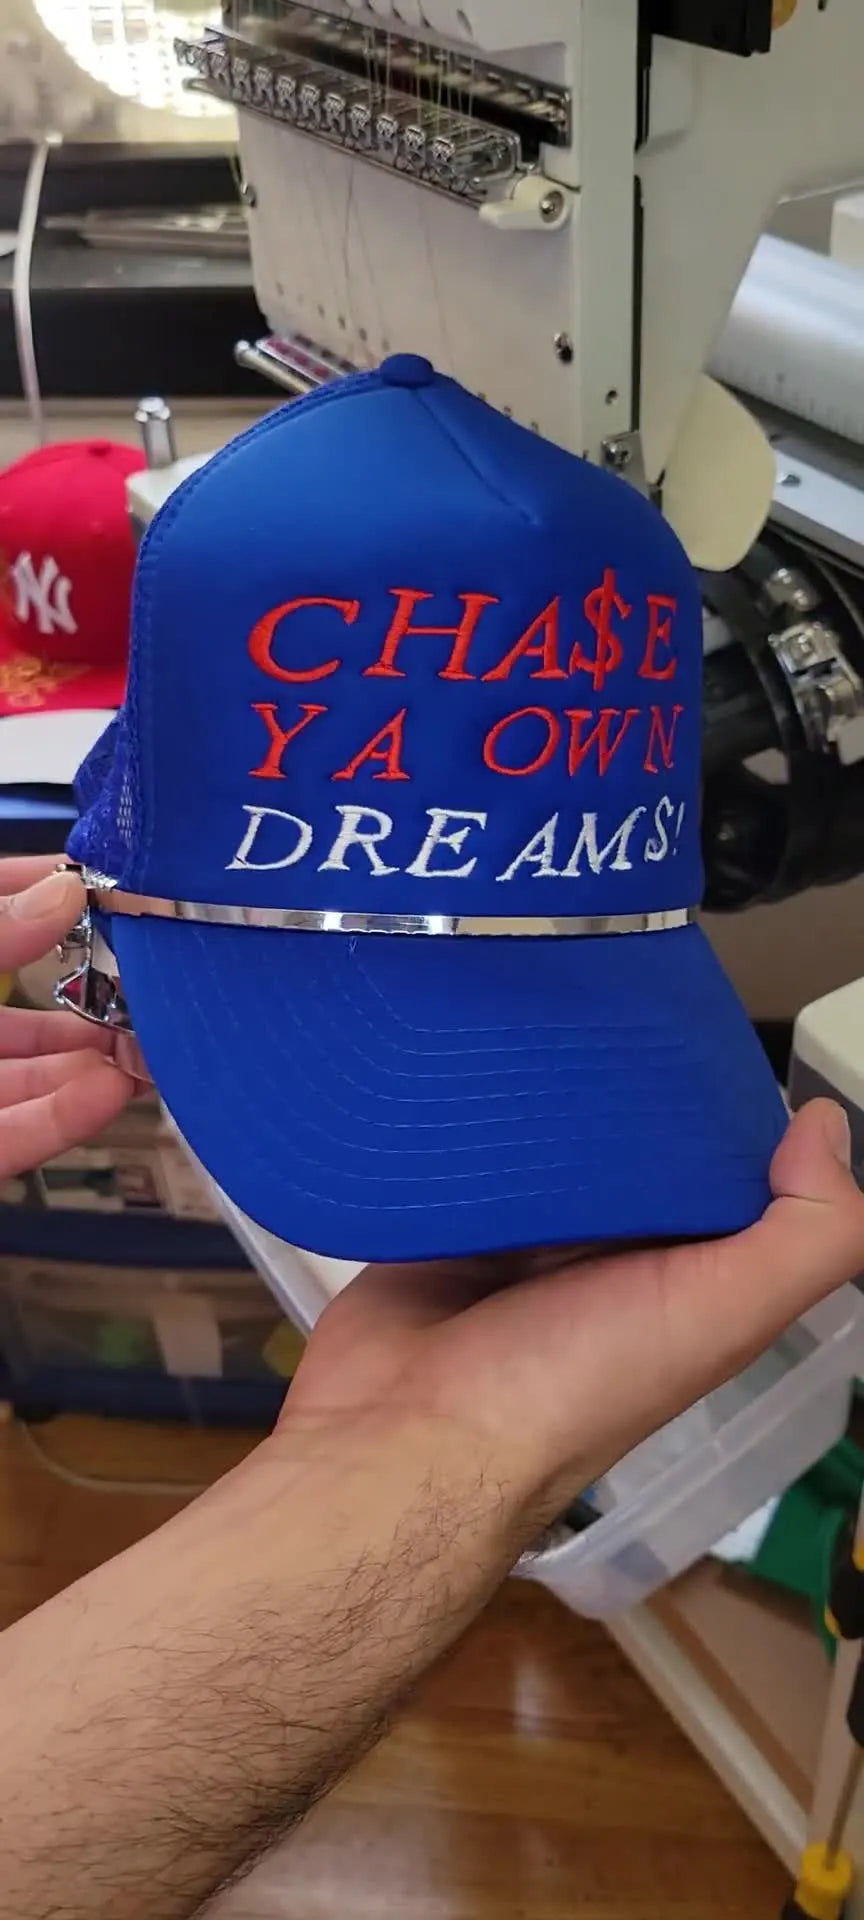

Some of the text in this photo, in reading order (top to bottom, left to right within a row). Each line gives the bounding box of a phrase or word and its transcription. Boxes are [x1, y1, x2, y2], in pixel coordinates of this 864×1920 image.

[11, 551, 78, 634] NY
[247, 567, 677, 691] CHA$E
[248, 703, 684, 781] YA OWN
[225, 796, 685, 882] DREAMS!
